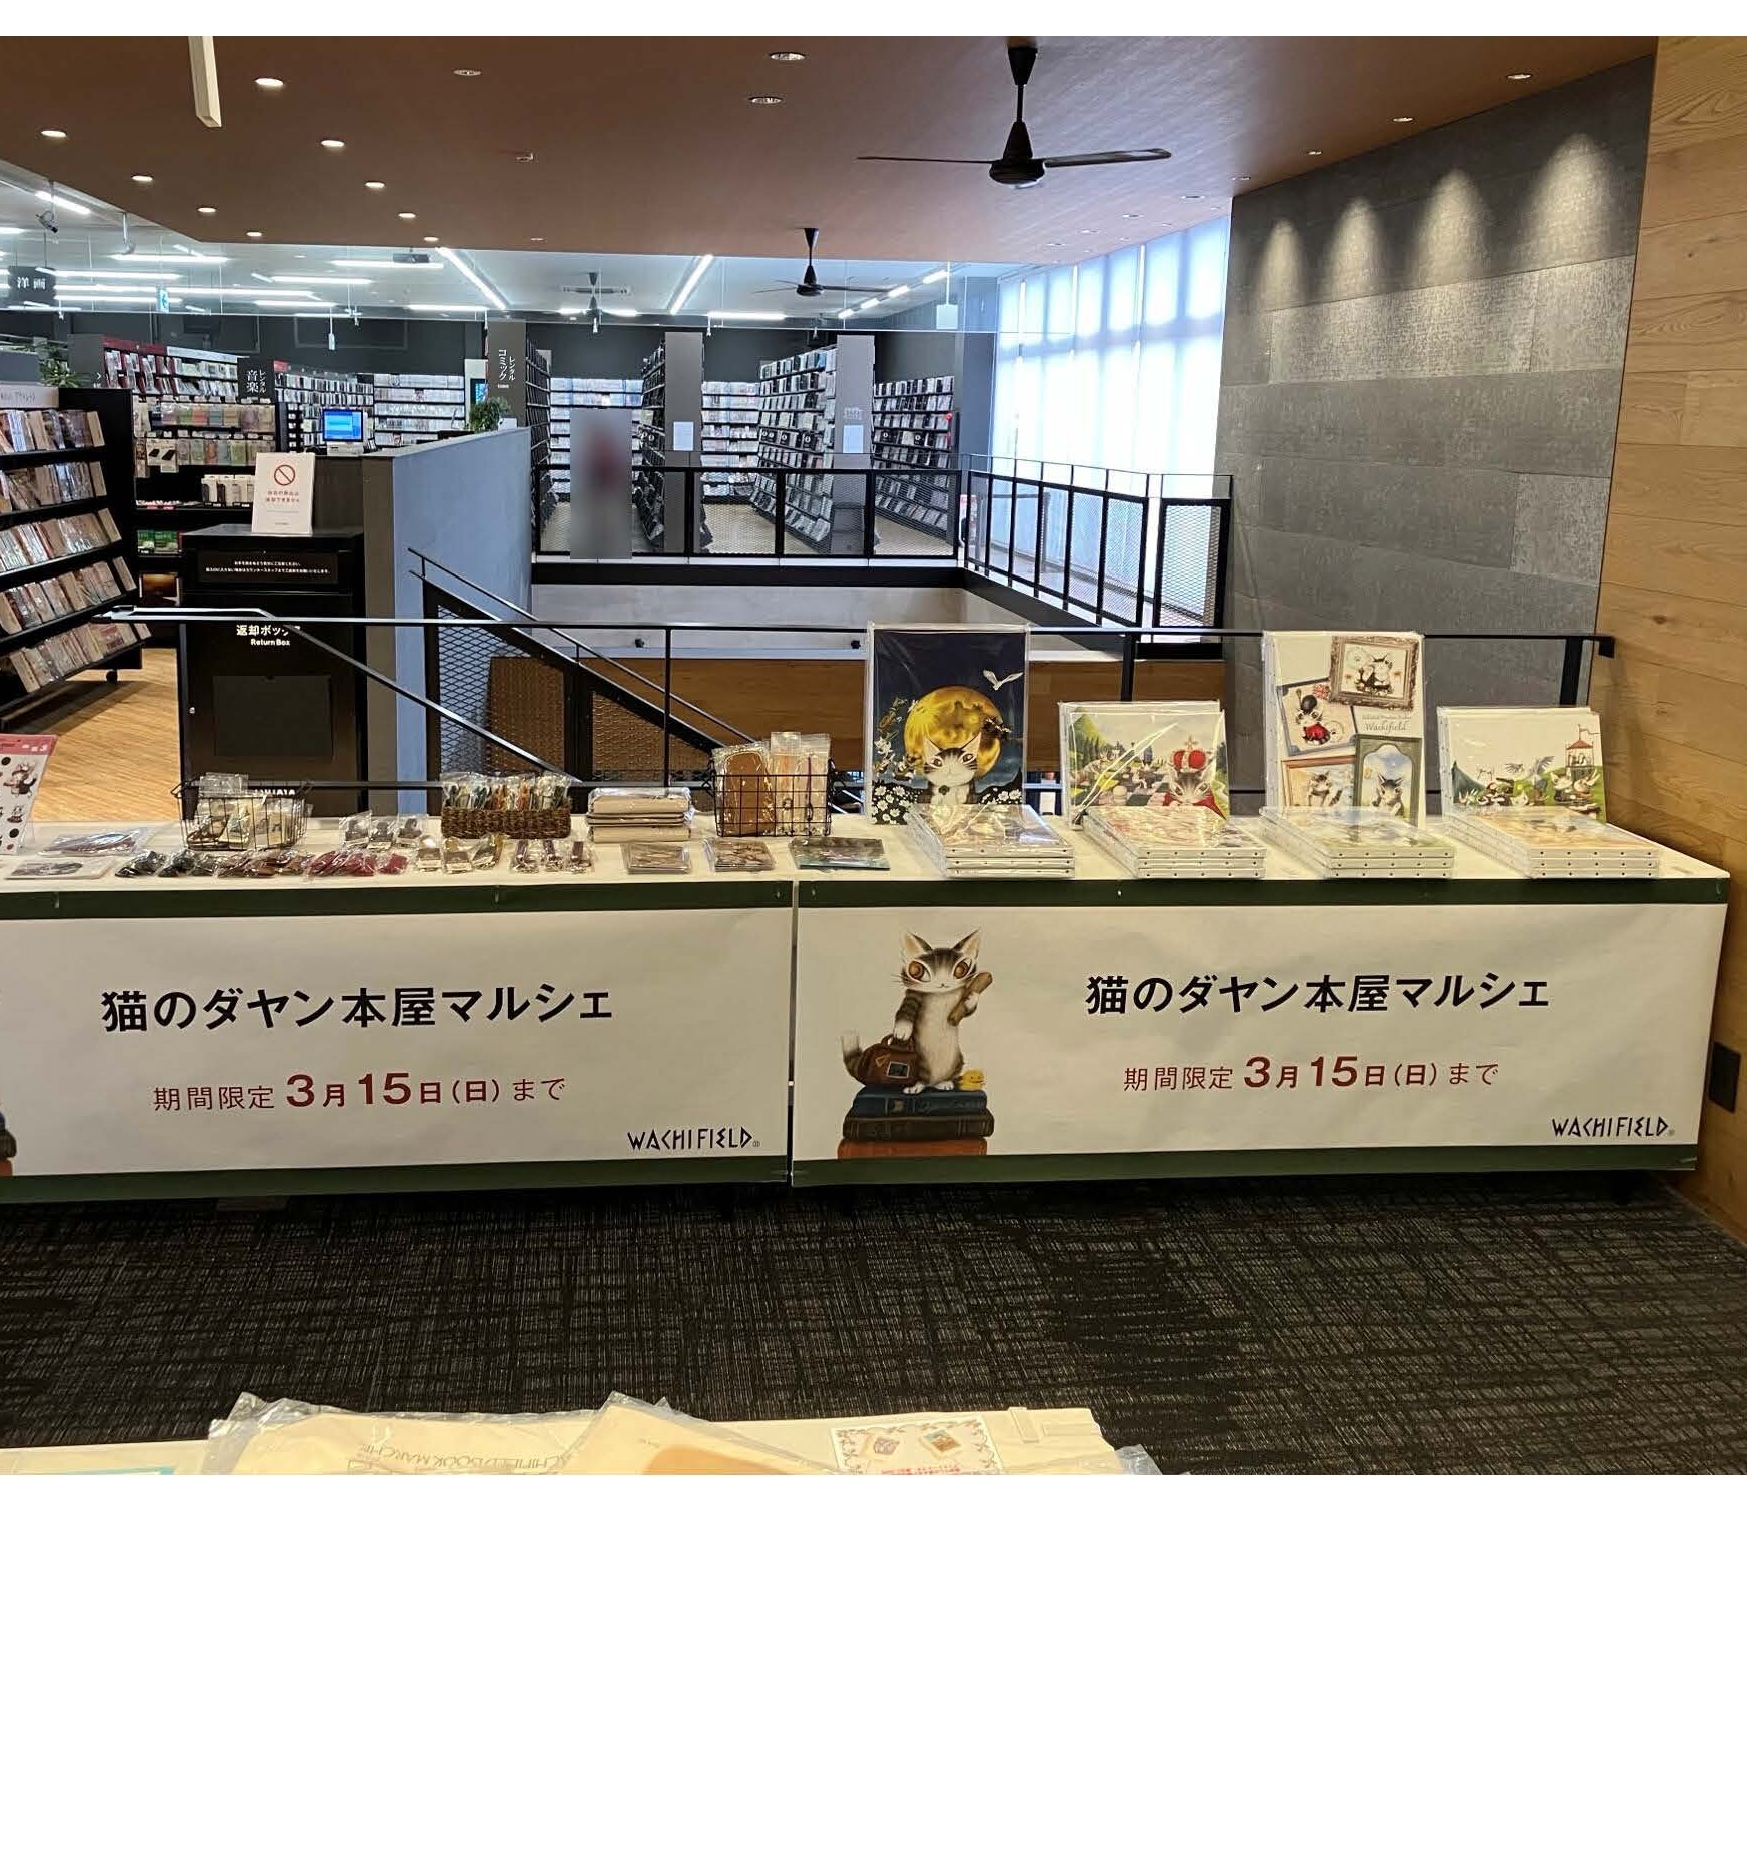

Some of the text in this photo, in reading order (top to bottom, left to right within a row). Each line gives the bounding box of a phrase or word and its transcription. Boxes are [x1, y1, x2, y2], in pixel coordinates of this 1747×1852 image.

[247, 369, 258, 393] 音楽
[498, 349, 507, 381] コミック
[250, 638, 290, 646] Return Box
[101, 983, 613, 1033] 猫のダヤン本屋マルシェ
[1086, 971, 1550, 1016] 猫のダヤン本屋マルシェ
